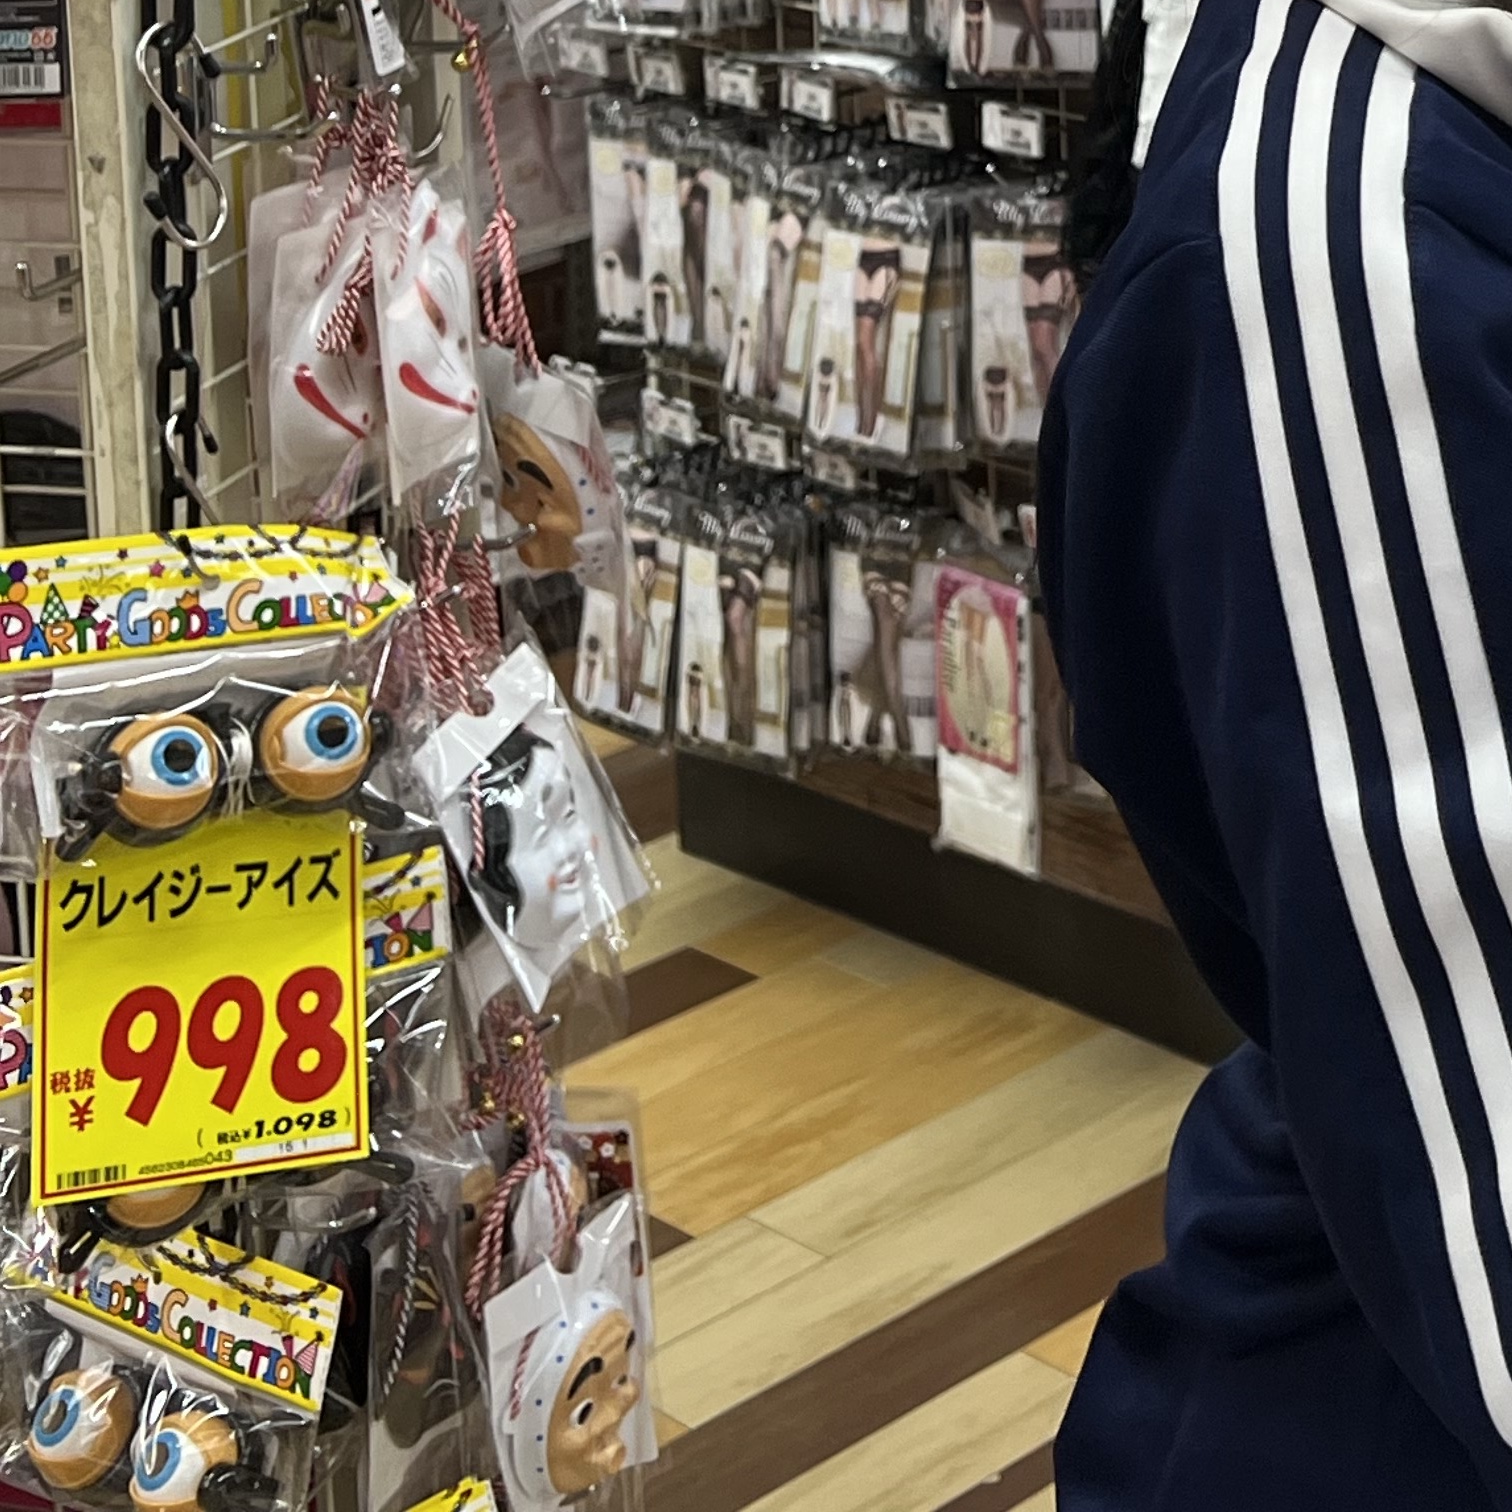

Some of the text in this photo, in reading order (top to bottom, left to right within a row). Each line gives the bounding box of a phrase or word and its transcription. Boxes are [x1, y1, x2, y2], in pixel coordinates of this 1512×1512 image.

[117, 587, 227, 647] GOODS
[59, 848, 342, 932] クレイジーアイズ
[50, 1067, 96, 1095] 税抜
[100, 965, 348, 1127] 998
